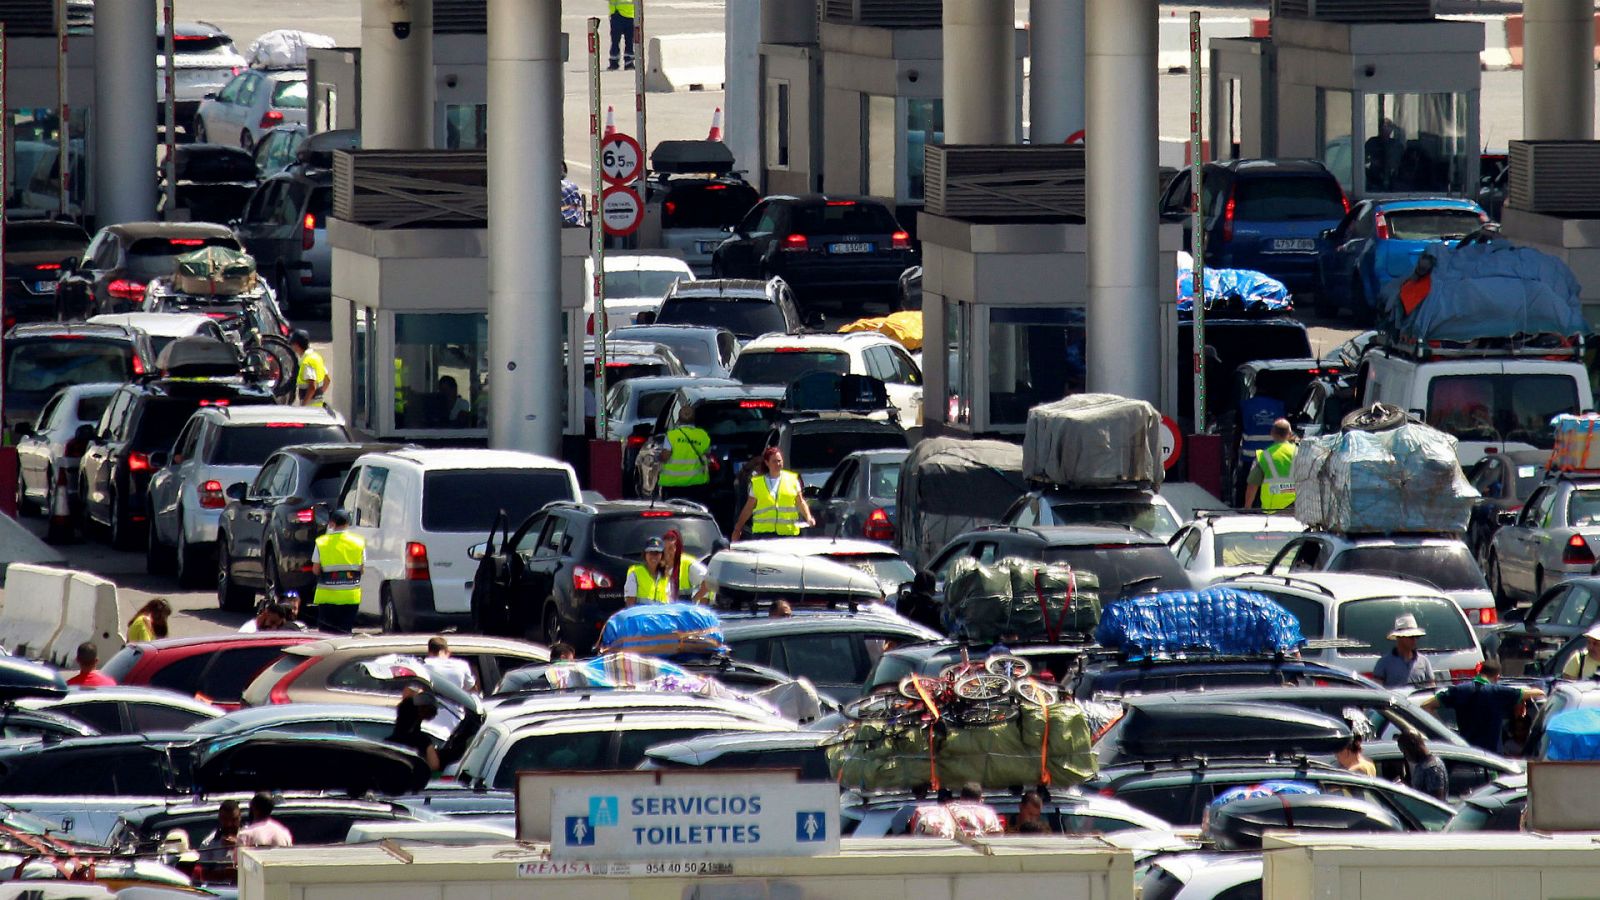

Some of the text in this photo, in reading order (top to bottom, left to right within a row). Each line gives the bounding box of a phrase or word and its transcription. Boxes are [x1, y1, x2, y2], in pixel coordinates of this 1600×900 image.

[631, 796, 762, 816] SERVICIOS
[632, 825, 761, 845] TOILETTES
[525, 863, 592, 874] REMSA
[646, 864, 665, 874] 954
[668, 864, 681, 873] 40
[684, 863, 697, 873] 50
[700, 863, 712, 872] 21
